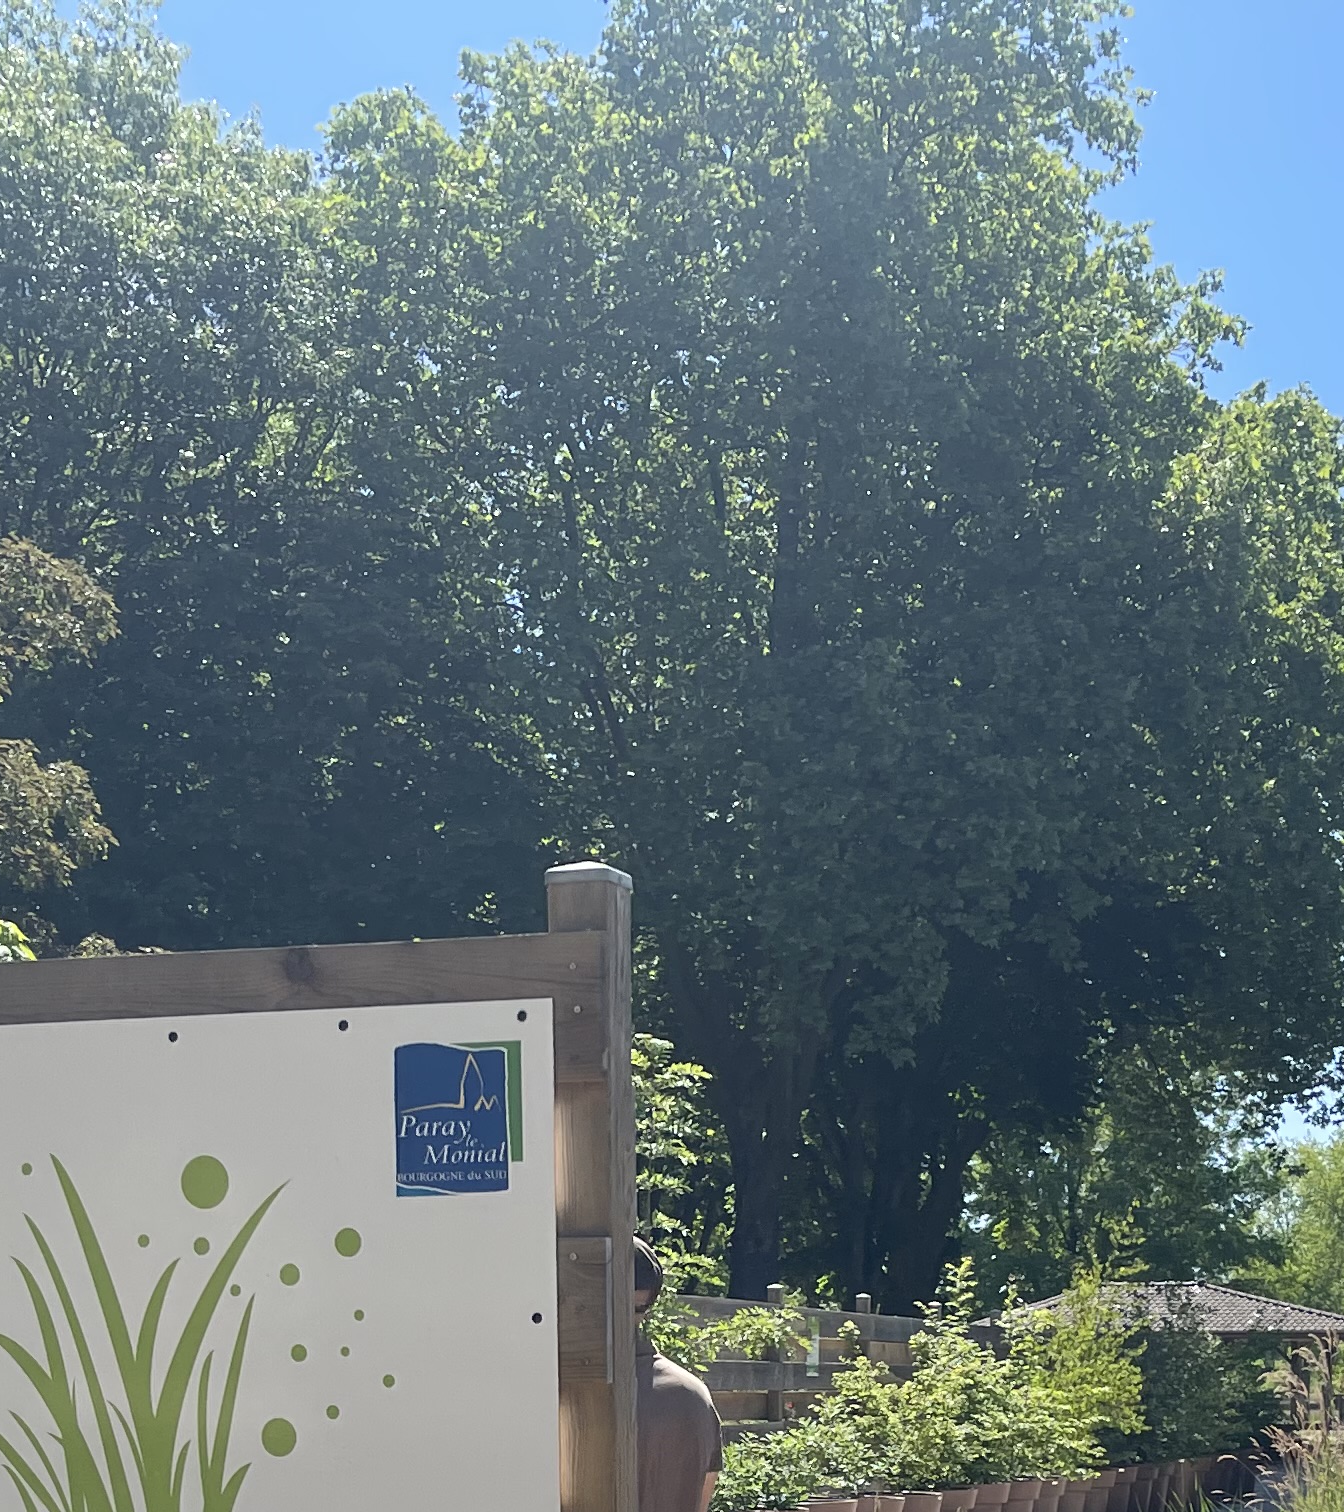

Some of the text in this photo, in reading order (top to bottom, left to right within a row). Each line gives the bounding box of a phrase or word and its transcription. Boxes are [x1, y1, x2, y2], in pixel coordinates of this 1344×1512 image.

[397, 1115, 471, 1145] Paray
[465, 1133, 478, 1147] le
[423, 1141, 506, 1165] Monial
[397, 1170, 507, 1182] BOURGOGNE du SUD
